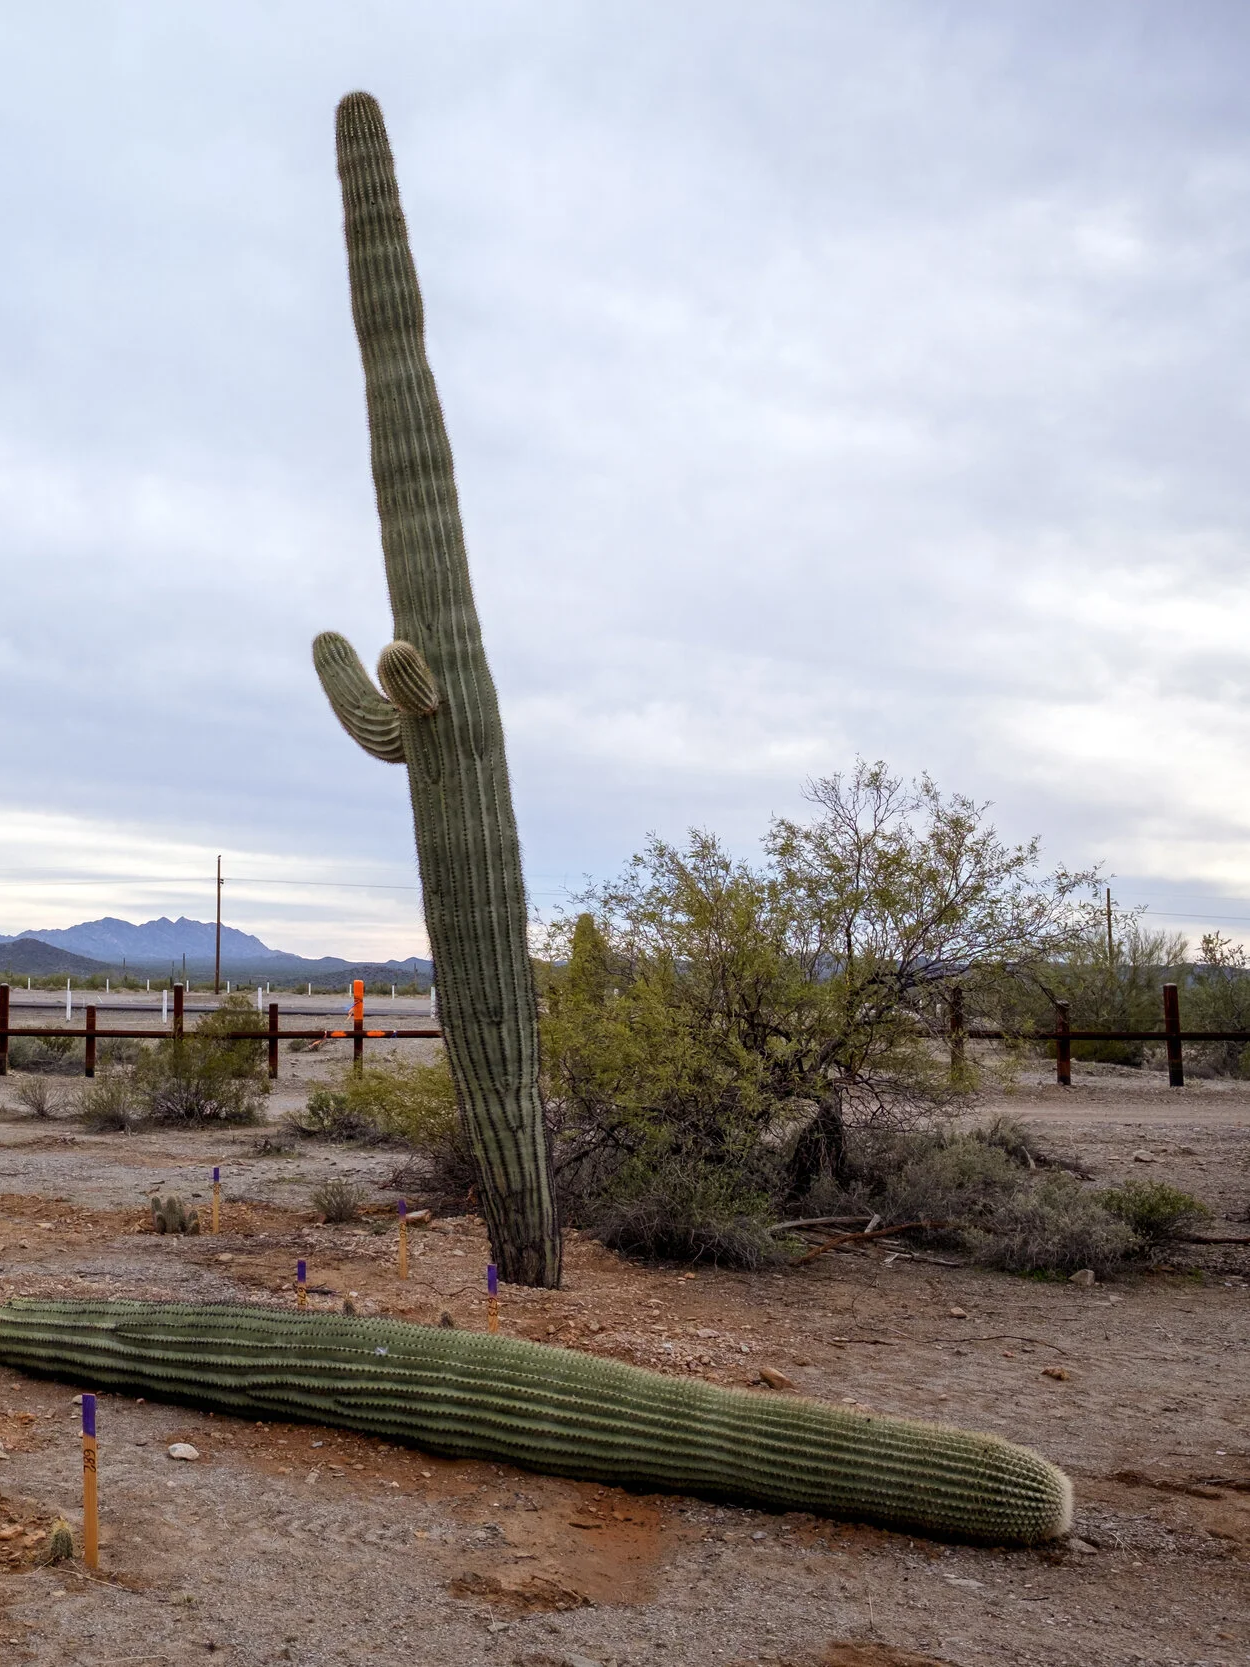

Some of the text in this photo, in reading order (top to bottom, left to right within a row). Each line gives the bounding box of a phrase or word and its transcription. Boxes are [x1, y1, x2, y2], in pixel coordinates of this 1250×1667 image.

[297, 1287, 307, 1306] 674
[487, 1297, 498, 1317] 673
[83, 1449, 97, 1474] 682
